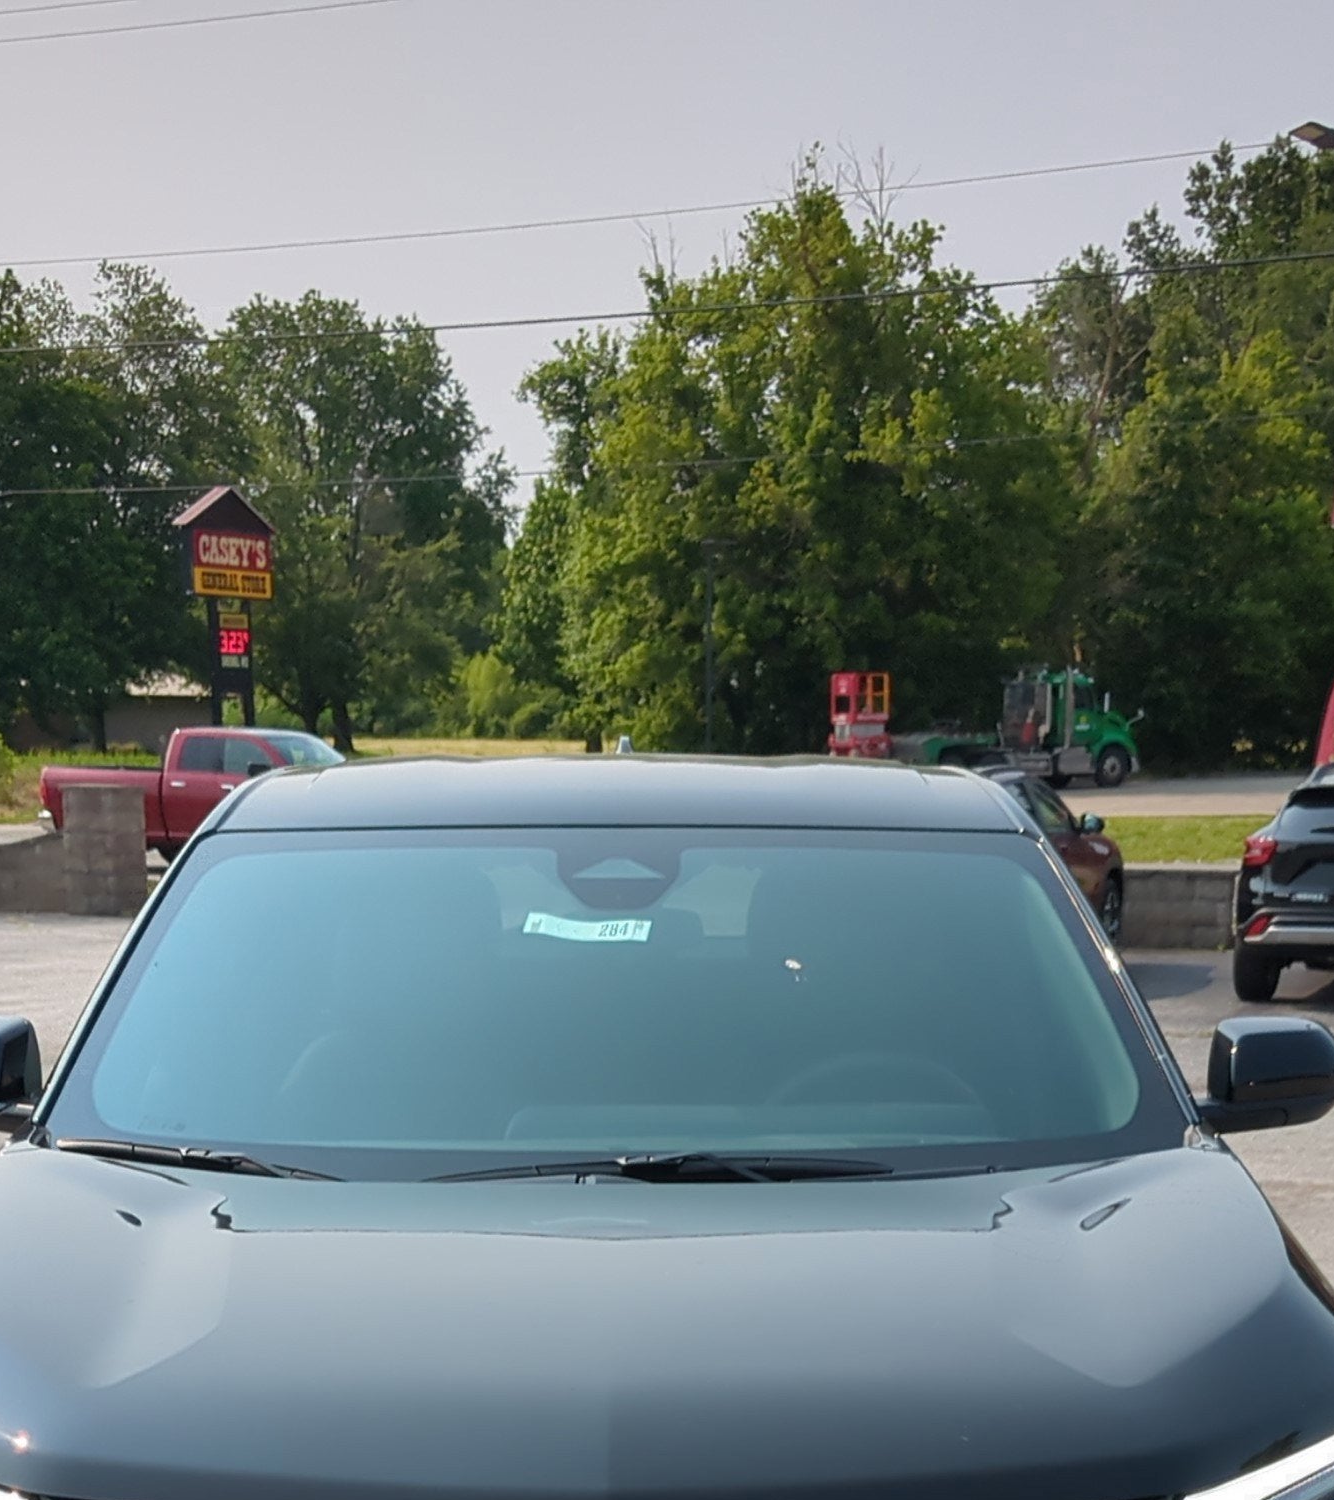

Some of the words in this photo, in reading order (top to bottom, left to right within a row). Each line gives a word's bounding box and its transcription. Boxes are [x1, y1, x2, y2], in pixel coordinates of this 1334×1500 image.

[198, 534, 267, 568] CASEY'S
[201, 571, 240, 592] GENERAL
[241, 574, 267, 594] STORE
[598, 923, 629, 938] 284
